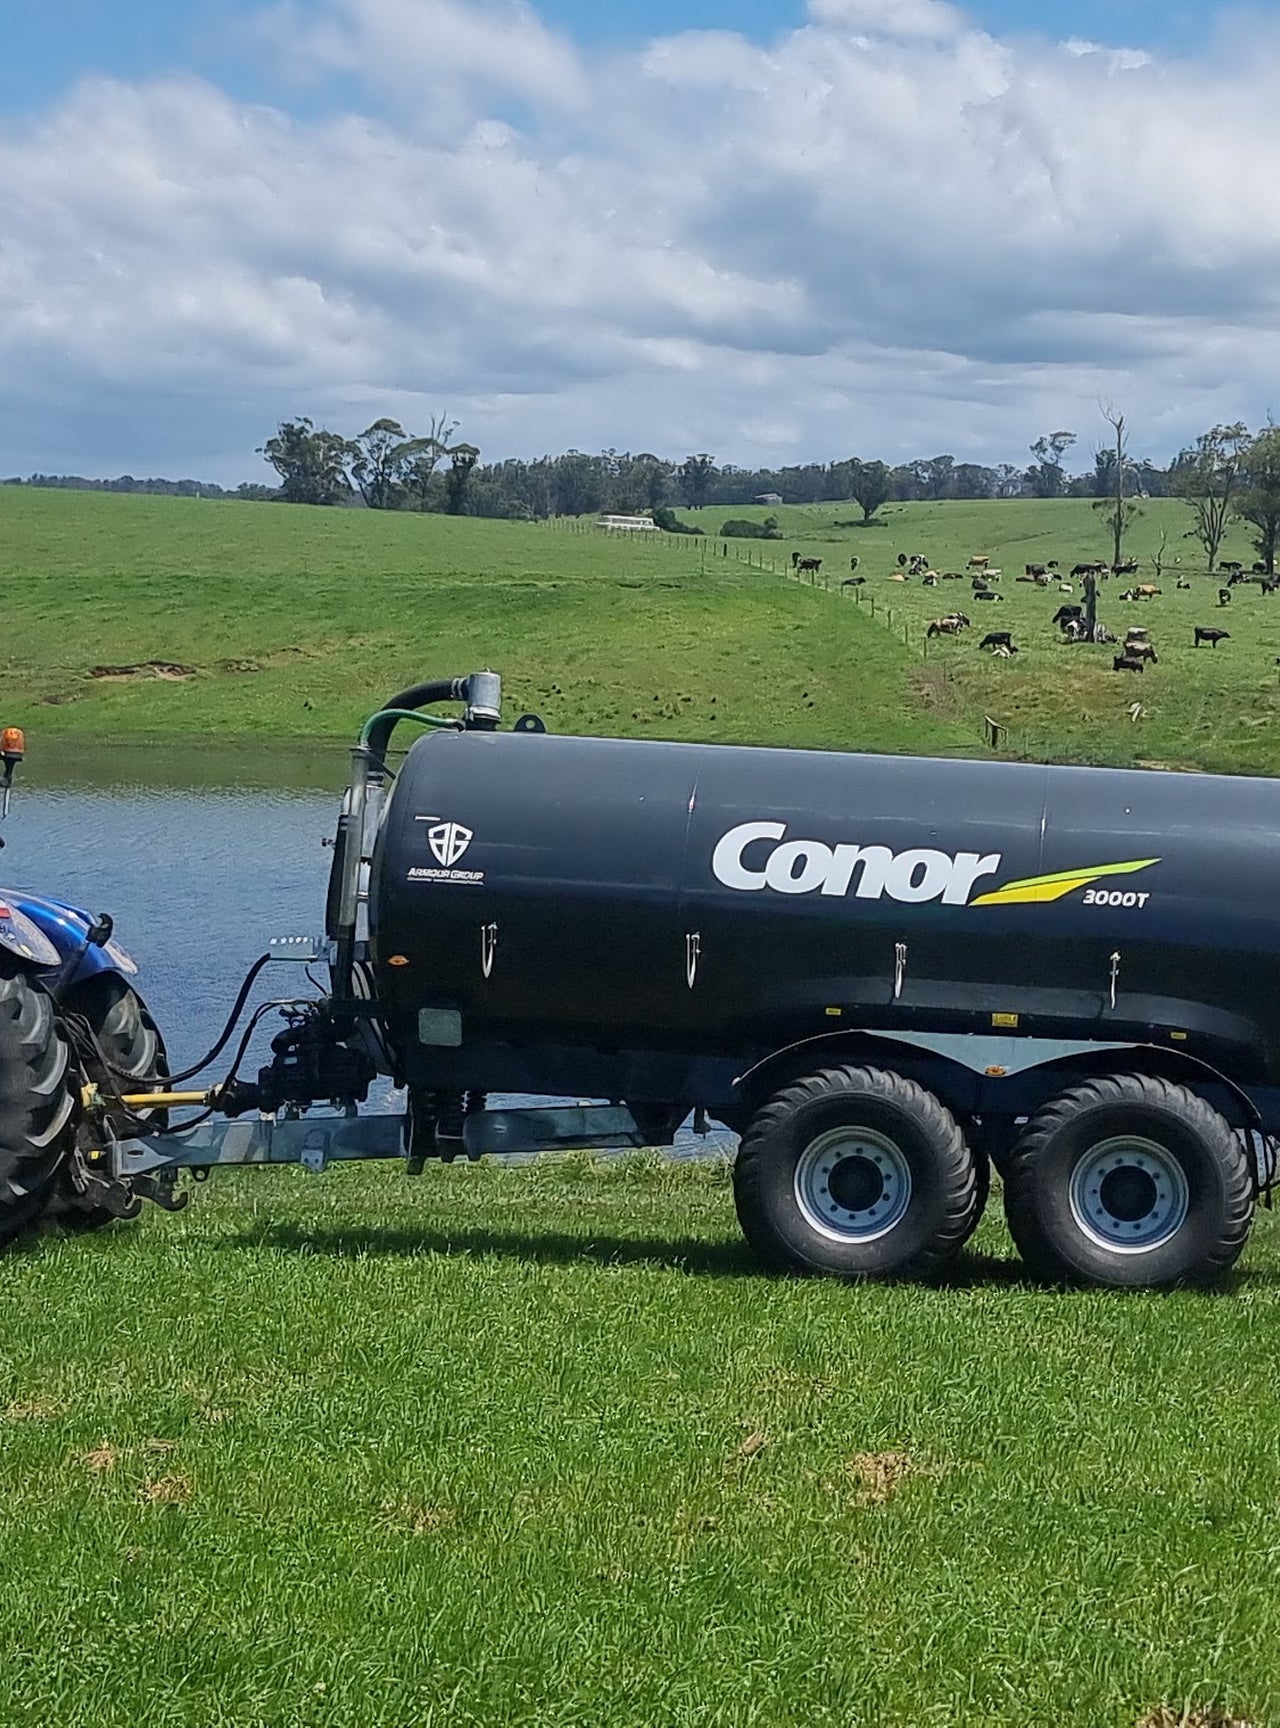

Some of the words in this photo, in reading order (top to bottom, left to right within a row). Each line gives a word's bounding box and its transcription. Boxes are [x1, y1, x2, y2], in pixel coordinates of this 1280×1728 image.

[712, 821, 1002, 905] Conor
[450, 870, 484, 881] GROUP
[1082, 889, 1150, 909] 3000T
